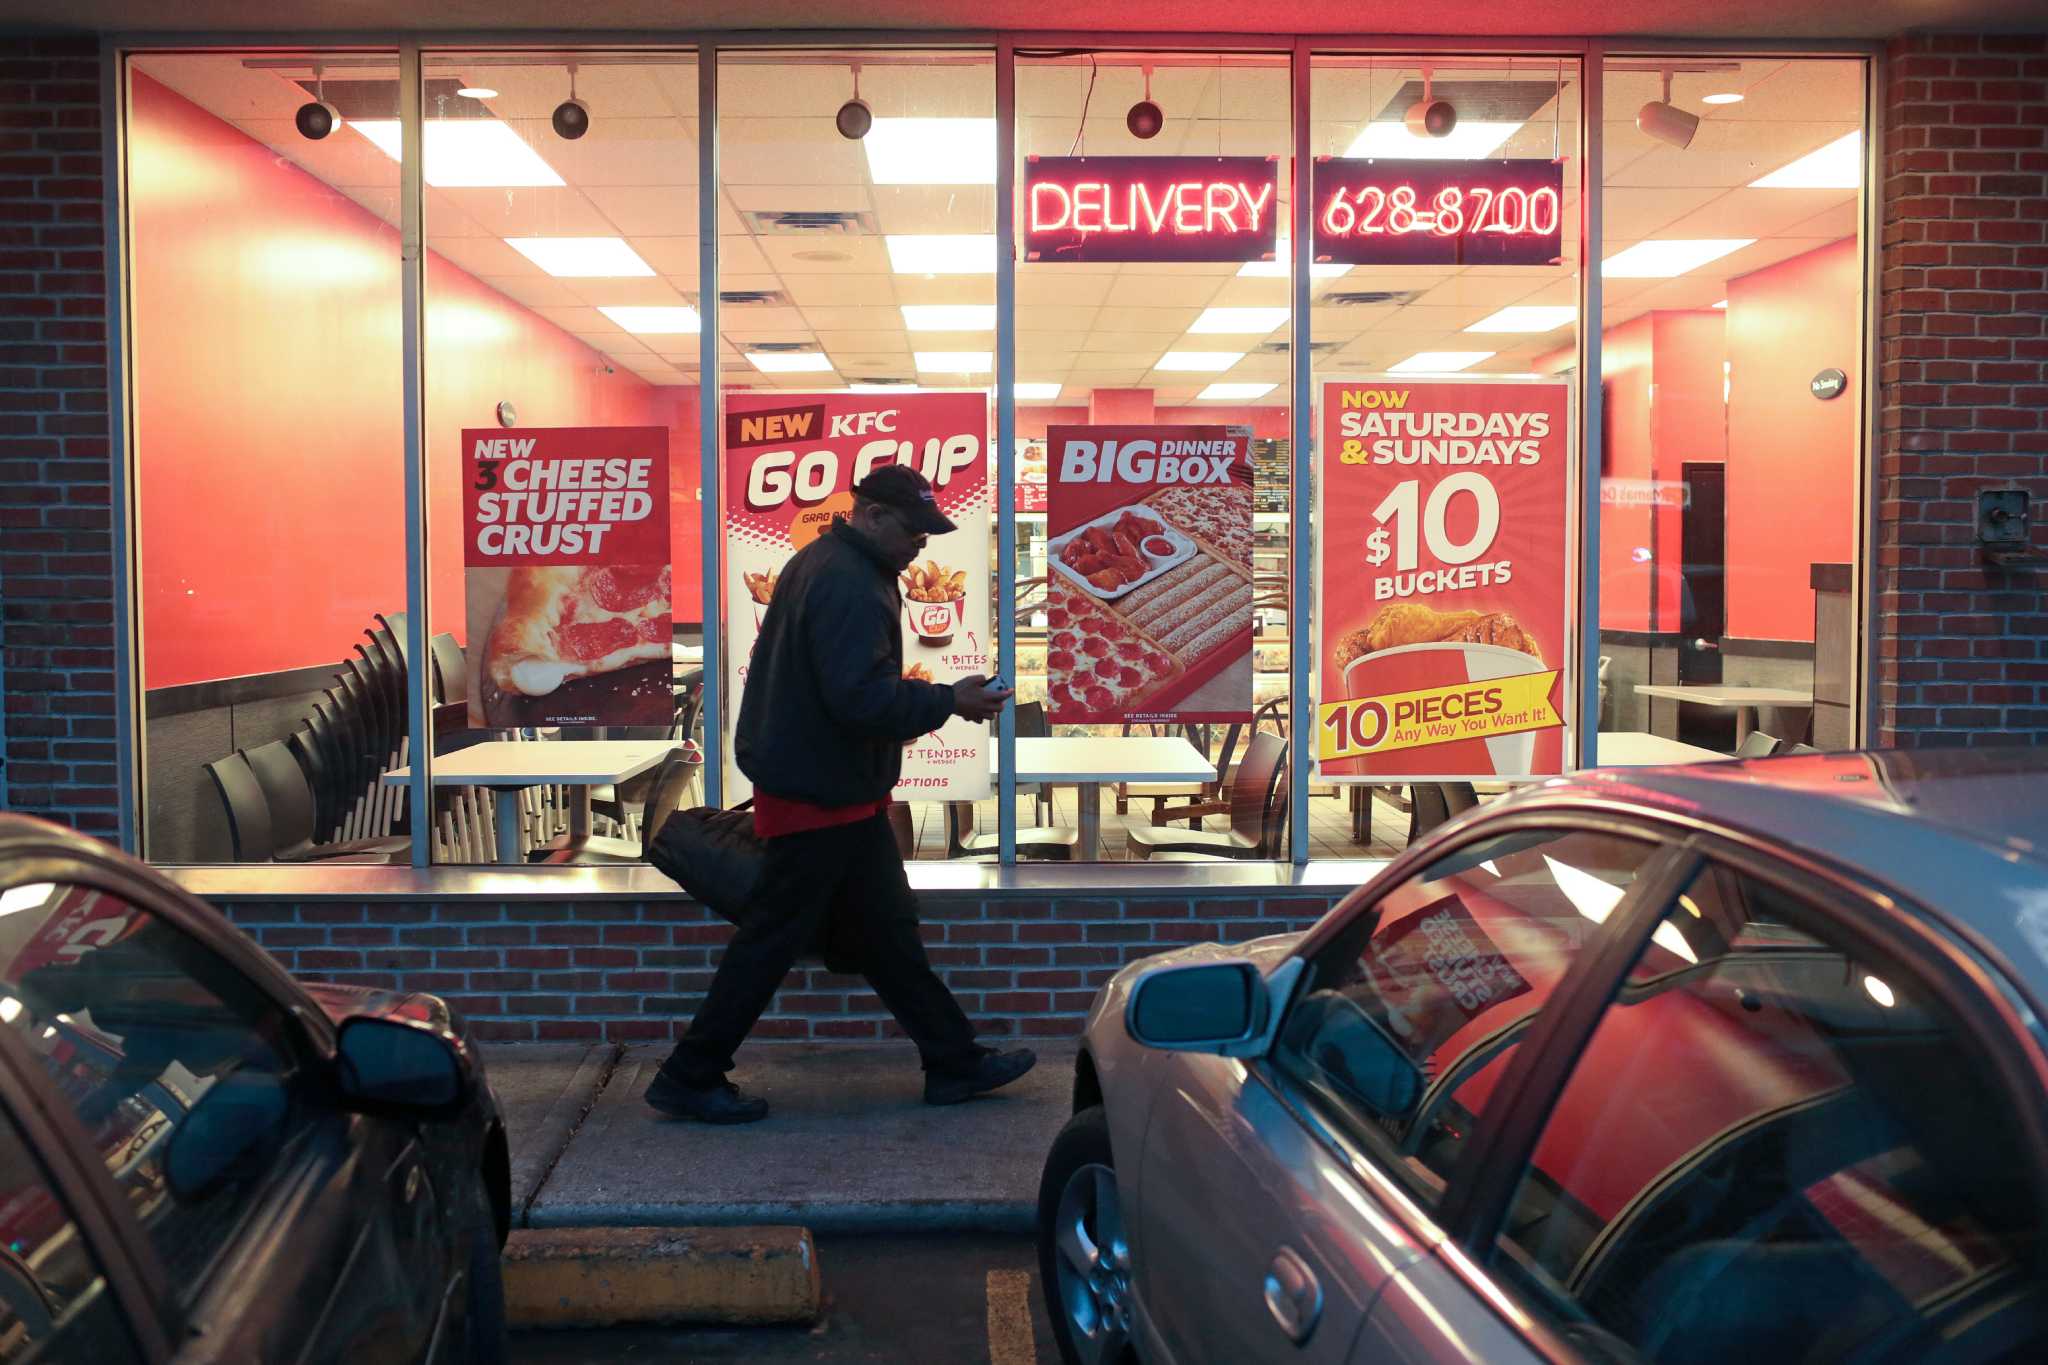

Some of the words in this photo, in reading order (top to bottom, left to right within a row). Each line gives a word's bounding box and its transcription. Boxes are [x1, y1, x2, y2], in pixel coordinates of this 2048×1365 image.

[1031, 182, 1271, 233] DELIVERY
[1326, 186, 1558, 234] 628-8700
[1341, 390, 1409, 408] NOW
[740, 411, 814, 442] NEW
[828, 409, 898, 438] KFC
[1341, 412, 1549, 438] SATURDAYS
[474, 439, 536, 459] NEW
[1059, 440, 1156, 483] BIG
[1160, 440, 1236, 456] DINNER
[1340, 439, 1368, 464] &
[1372, 440, 1540, 465] SUNDAYS
[474, 461, 499, 490] 3
[503, 458, 653, 490] CHEESE
[748, 450, 839, 507] GO
[1156, 457, 1236, 484] BOX
[476, 491, 652, 522] STUFFED
[802, 512, 830, 523] GRAB
[1365, 471, 1500, 571] $10
[477, 523, 612, 555] CRUST
[1374, 561, 1512, 600] BUCKETS
[942, 656, 948, 664] 4
[952, 655, 987, 664] BITES
[1324, 701, 1389, 751] 10
[1394, 688, 1503, 728] PIECES
[1394, 726, 1421, 743] Any
[1426, 722, 1456, 738] Way
[1461, 718, 1487, 732] You
[1491, 711, 1528, 727] Want
[1533, 708, 1546, 721] It!
[907, 750, 913, 759] 2
[918, 749, 976, 758] TENDERS
[896, 778, 949, 787] OPTIONS
